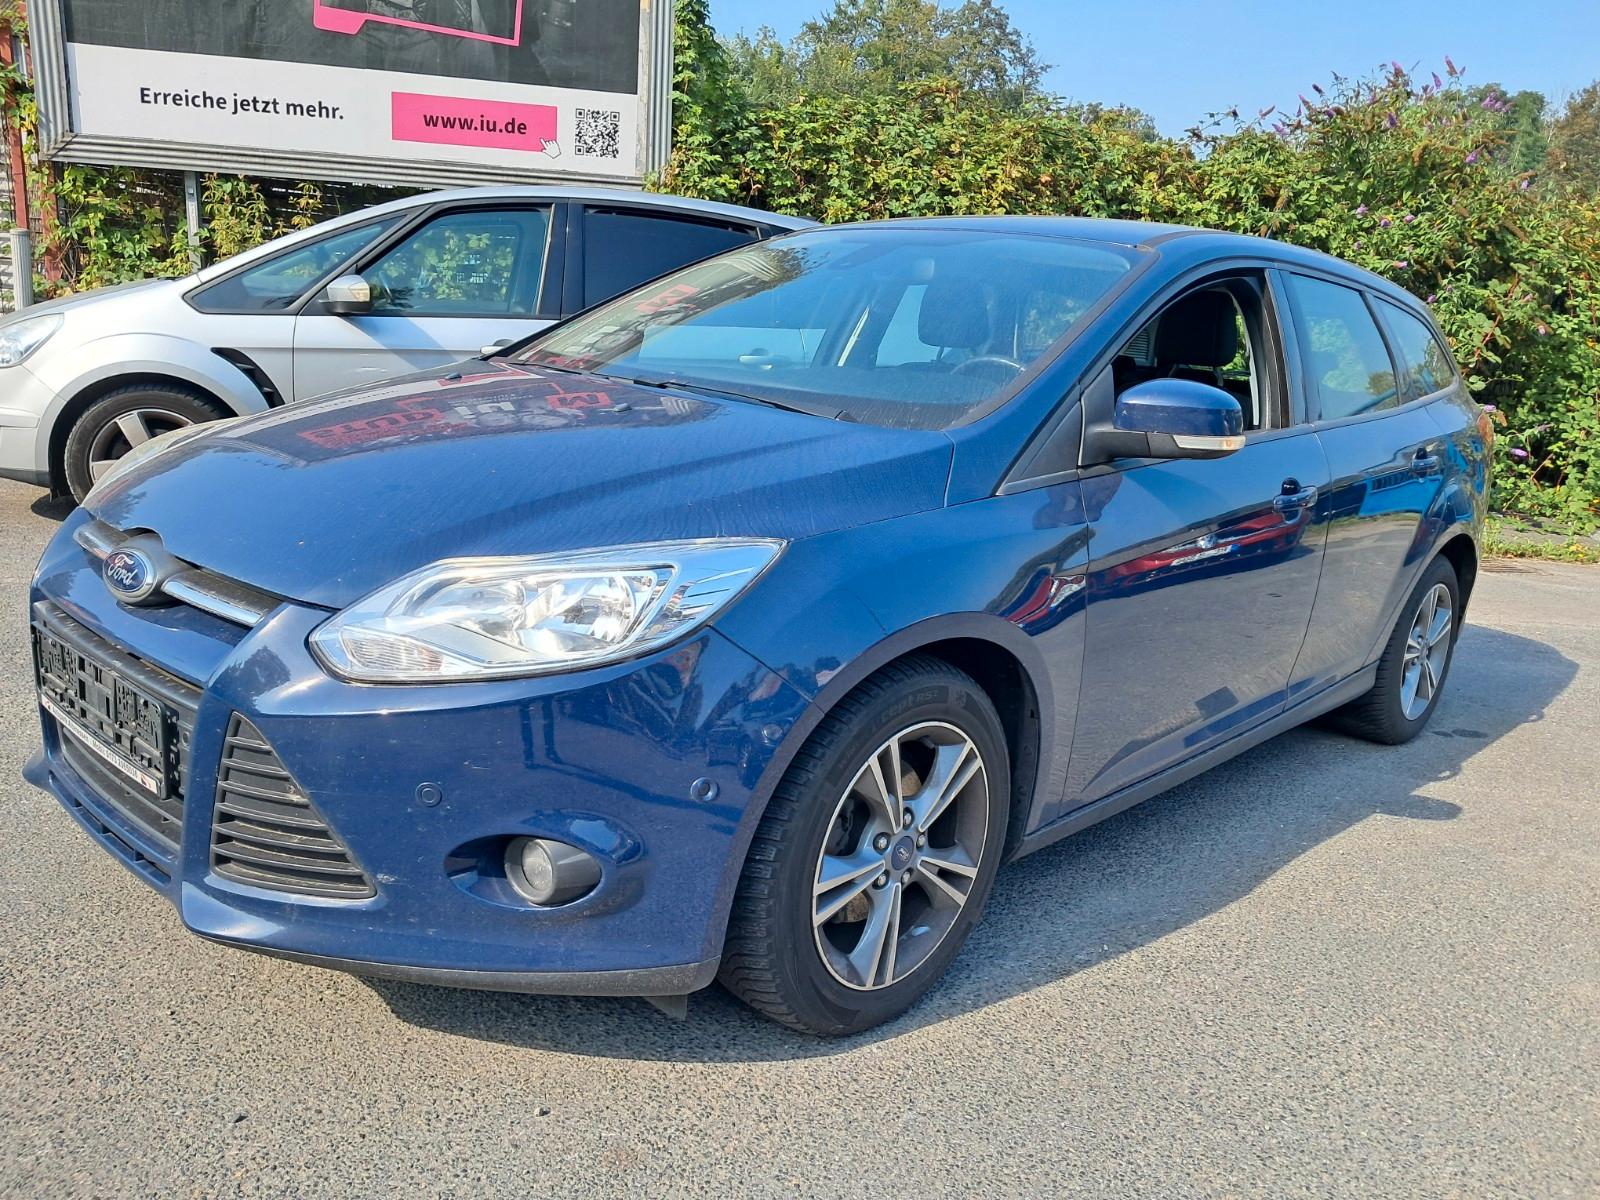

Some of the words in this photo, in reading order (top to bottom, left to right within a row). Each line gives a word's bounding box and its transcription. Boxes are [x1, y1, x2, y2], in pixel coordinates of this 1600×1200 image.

[139, 87, 228, 109] Erreiche
[232, 93, 280, 115] jetzt
[286, 101, 344, 120] mehr.
[423, 114, 528, 135] www.iu.de
[107, 553, 138, 586] Ford
